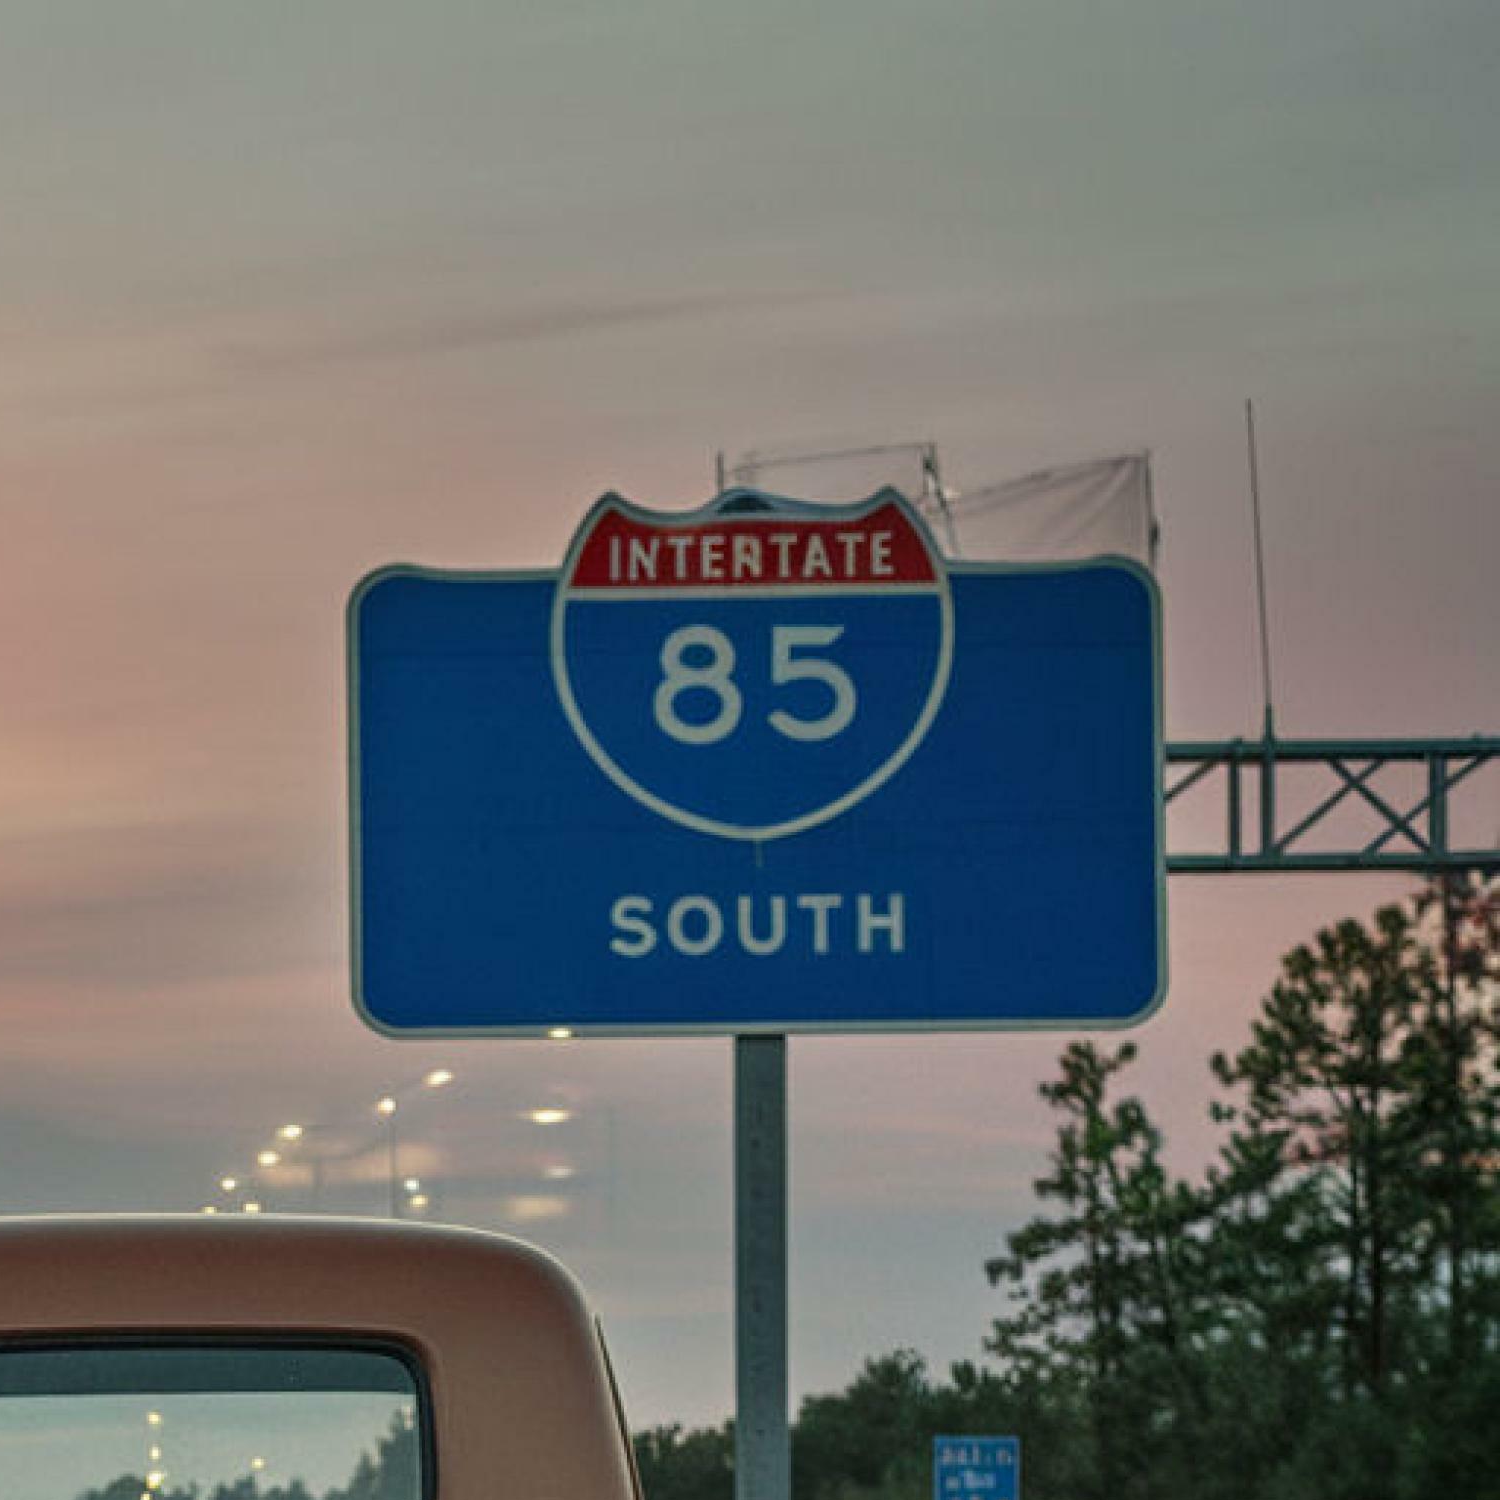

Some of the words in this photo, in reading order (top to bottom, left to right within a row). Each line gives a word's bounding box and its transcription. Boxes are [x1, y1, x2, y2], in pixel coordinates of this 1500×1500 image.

[608, 530, 895, 583] INTERTATE
[653, 624, 857, 745] 85
[610, 893, 906, 957] SOUTH
